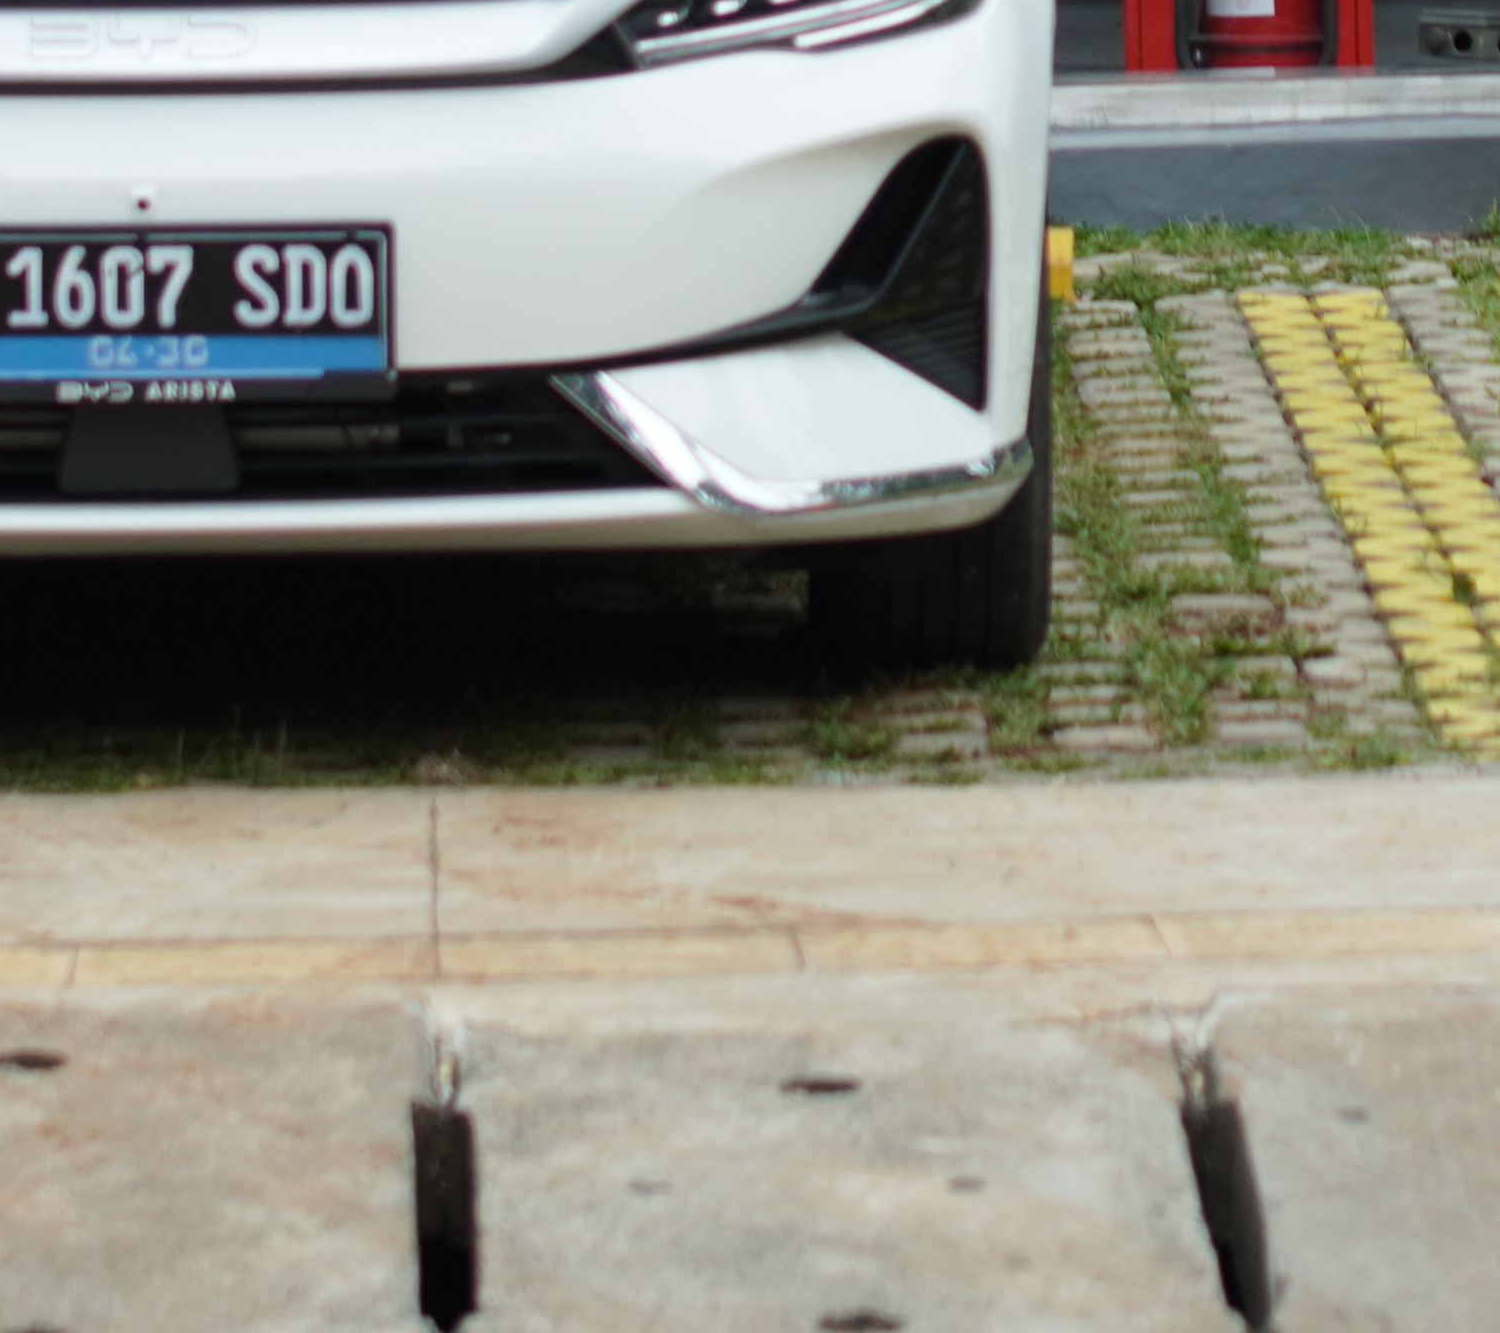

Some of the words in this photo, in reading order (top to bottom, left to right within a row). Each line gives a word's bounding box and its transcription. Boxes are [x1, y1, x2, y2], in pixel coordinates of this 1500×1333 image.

[29, 13, 258, 60] BYD
[6, 244, 194, 329] 1607
[57, 380, 134, 402] BYD
[145, 379, 236, 401] ARISTA
